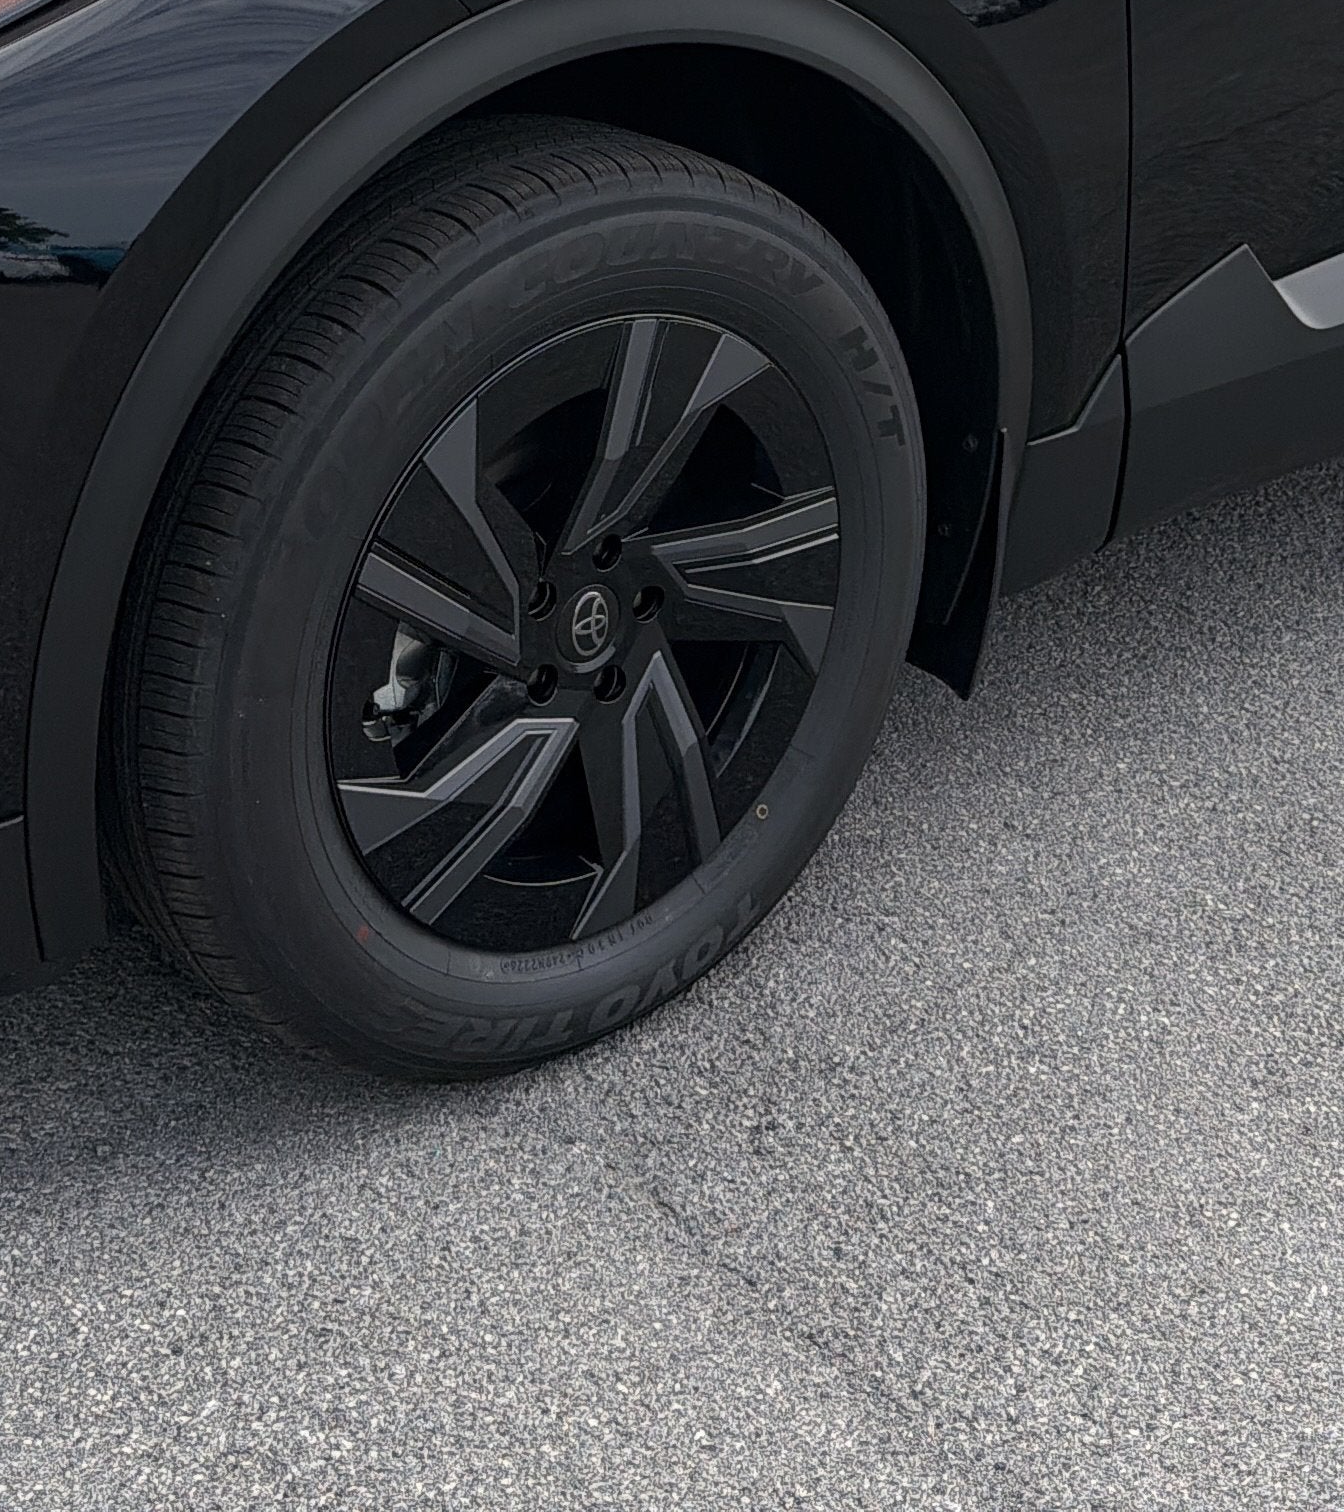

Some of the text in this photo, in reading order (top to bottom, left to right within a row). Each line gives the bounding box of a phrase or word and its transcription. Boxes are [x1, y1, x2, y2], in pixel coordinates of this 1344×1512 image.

[508, 220, 827, 310] COUNTRY
[841, 325, 906, 448] H/T
[584, 892, 761, 1034] TOYO
